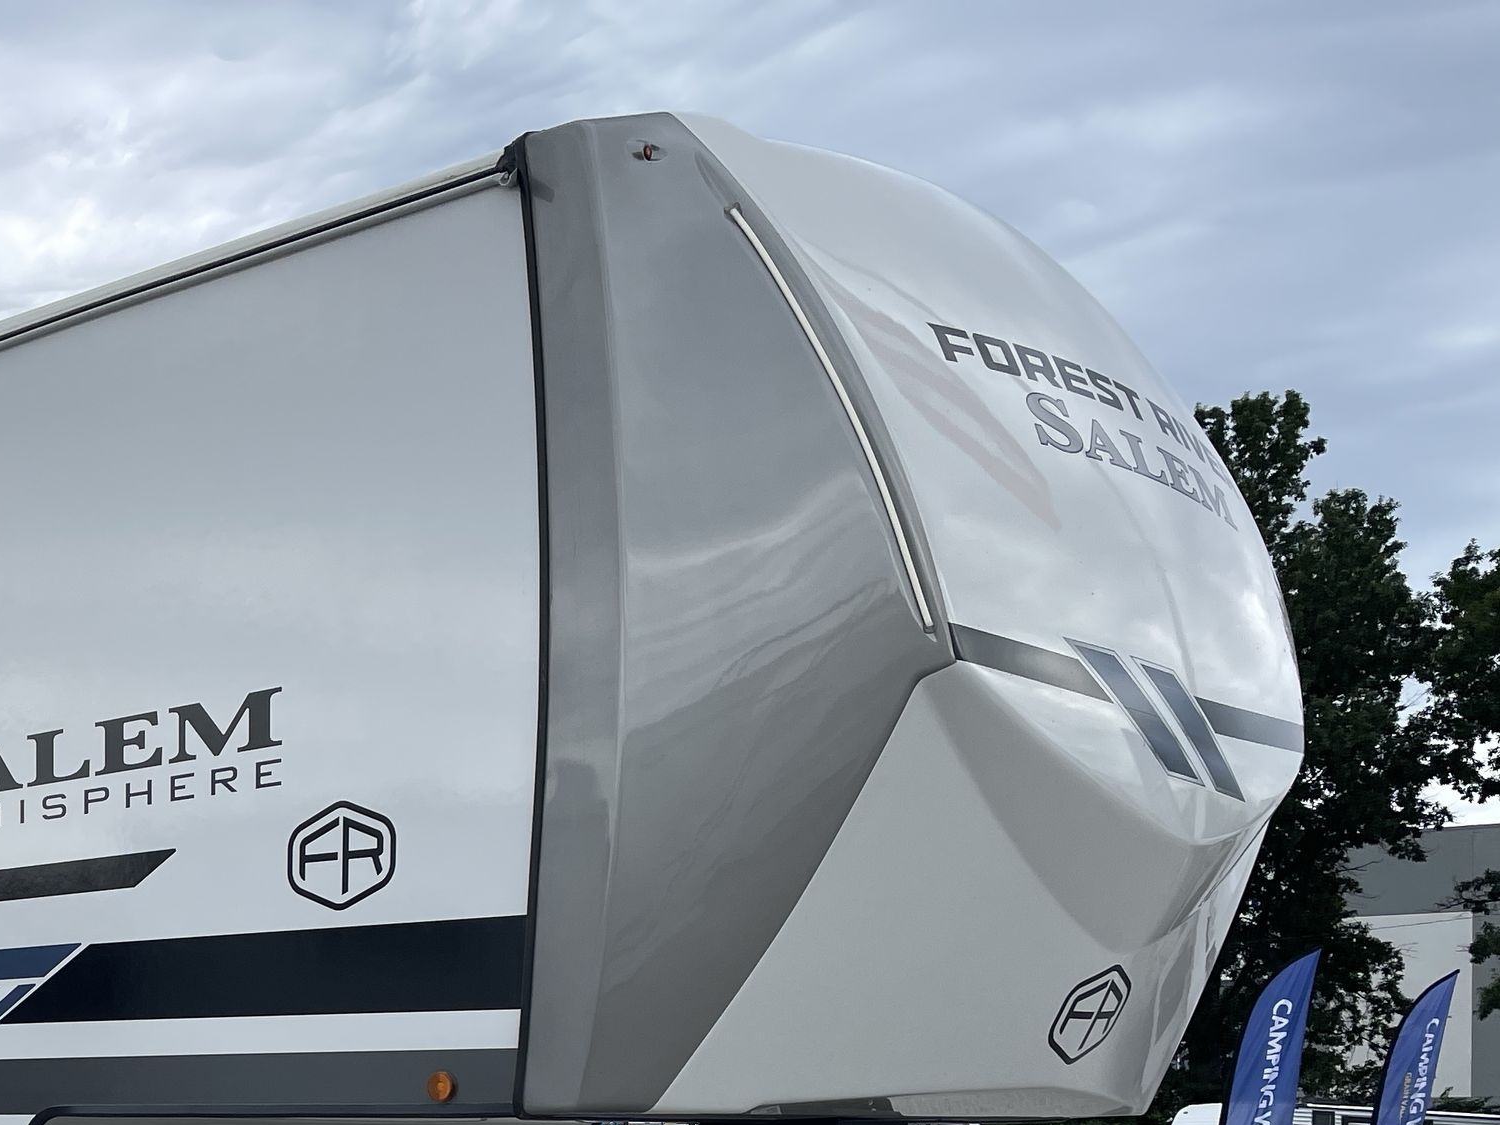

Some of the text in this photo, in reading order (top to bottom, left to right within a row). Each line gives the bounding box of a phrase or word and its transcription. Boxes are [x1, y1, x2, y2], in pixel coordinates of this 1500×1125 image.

[926, 321, 1144, 421] FOREST
[1025, 391, 1239, 532] SALEM
[1258, 998, 1293, 1109] CAMPING
